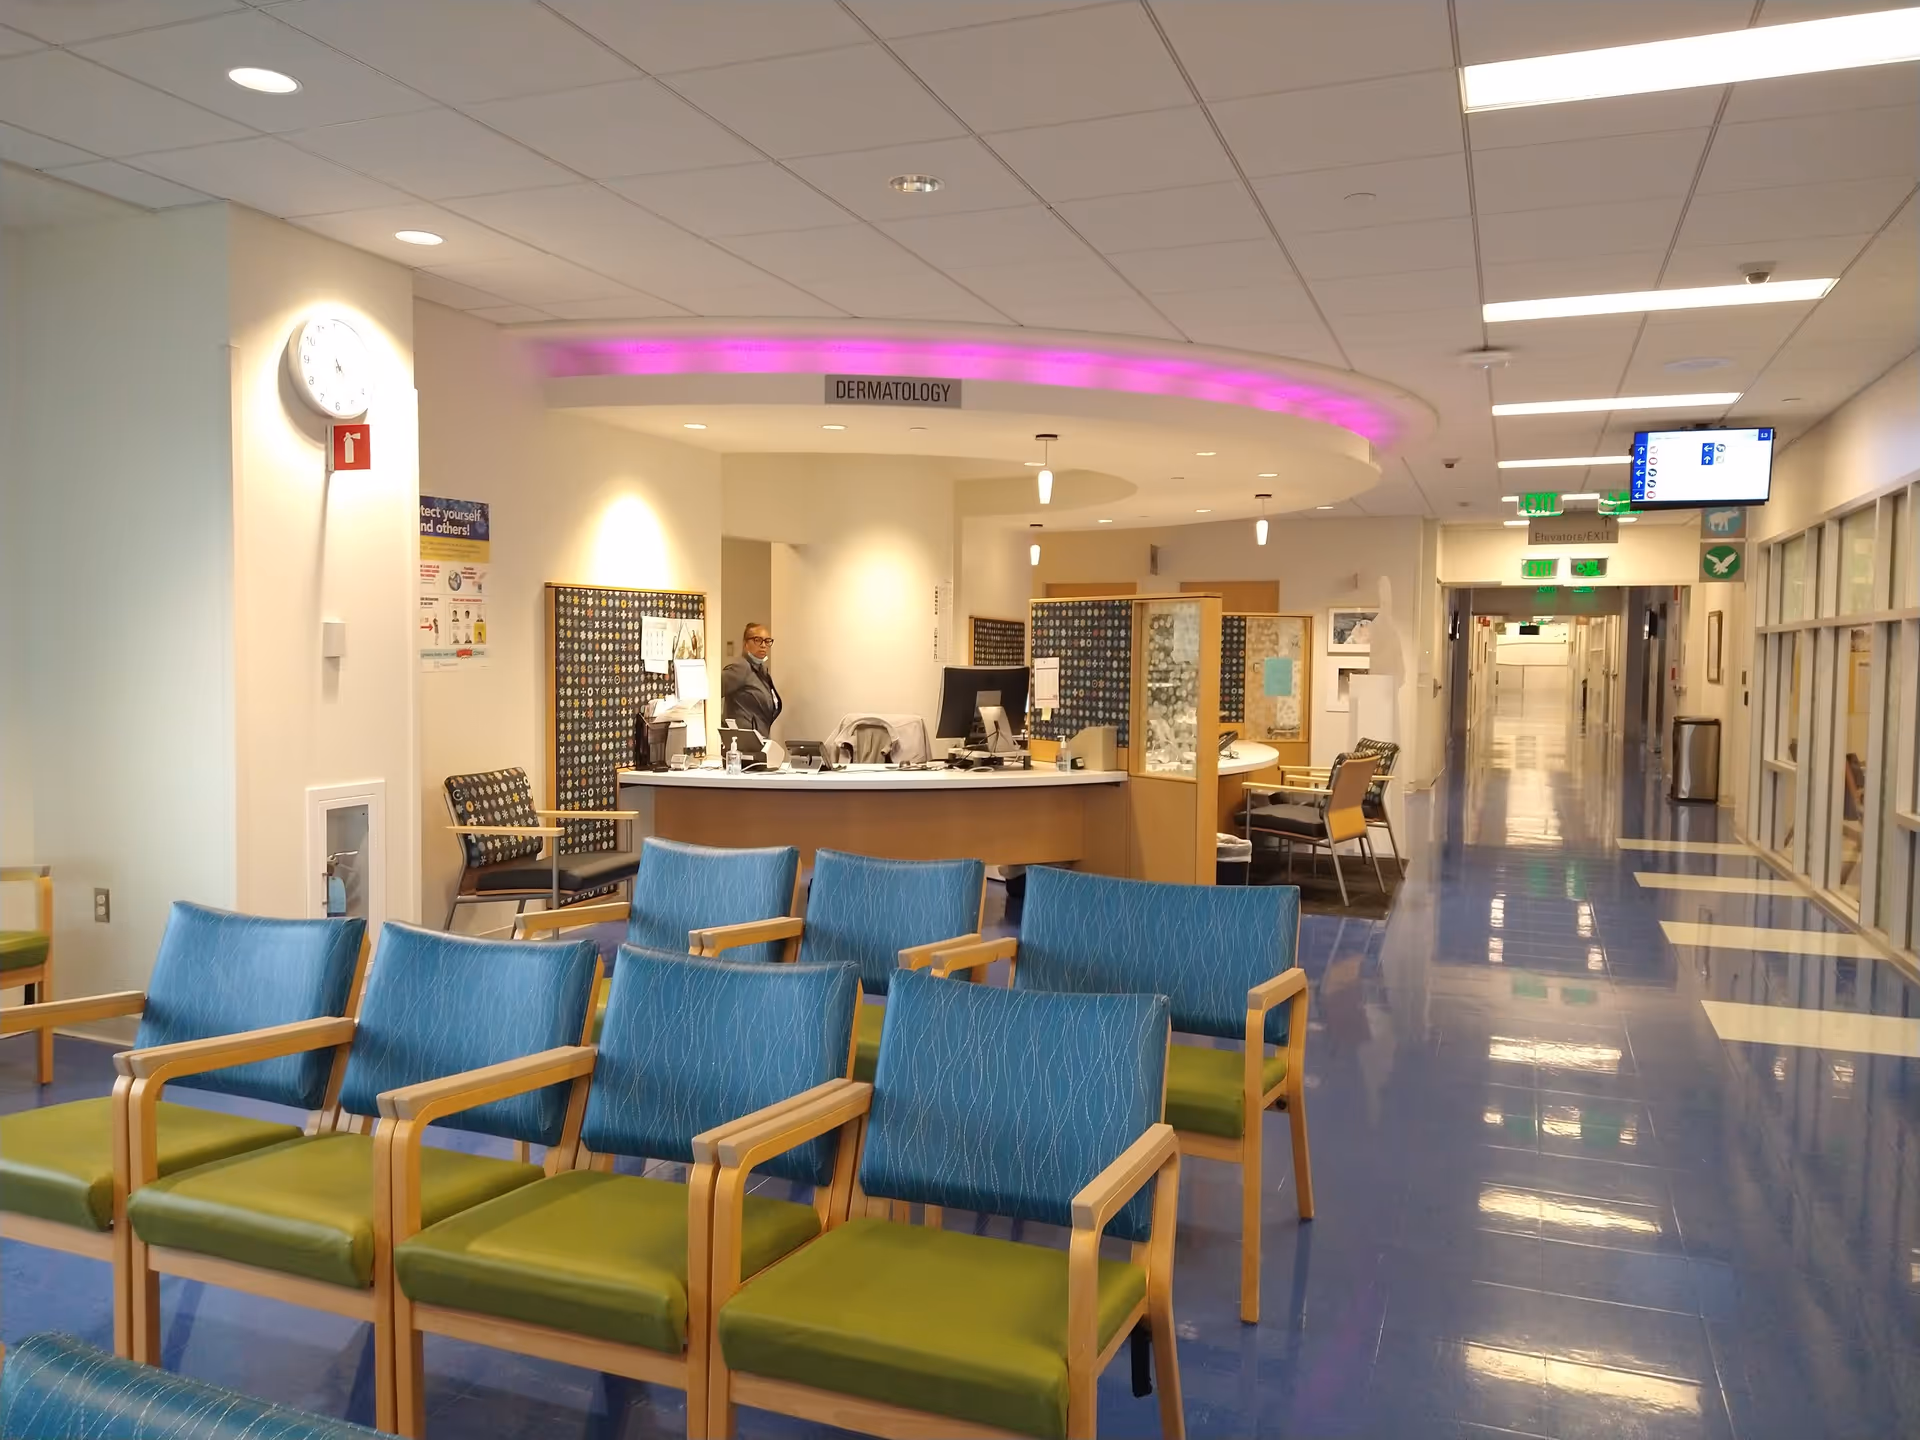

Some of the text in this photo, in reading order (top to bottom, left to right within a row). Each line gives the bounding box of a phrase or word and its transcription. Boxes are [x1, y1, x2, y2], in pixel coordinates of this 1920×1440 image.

[305, 336, 316, 347] 10
[303, 354, 310, 364] 9
[308, 375, 315, 386] 8
[319, 392, 325, 402] 7
[836, 380, 951, 402] DERMATOLOGY
[335, 401, 341, 411] 6
[1525, 493, 1558, 513] EXIT
[420, 505, 481, 522] tect yourself
[420, 519, 470, 536] nd others!
[1534, 531, 1611, 543] Elevators/EXIT
[1527, 560, 1553, 577] EXIT
